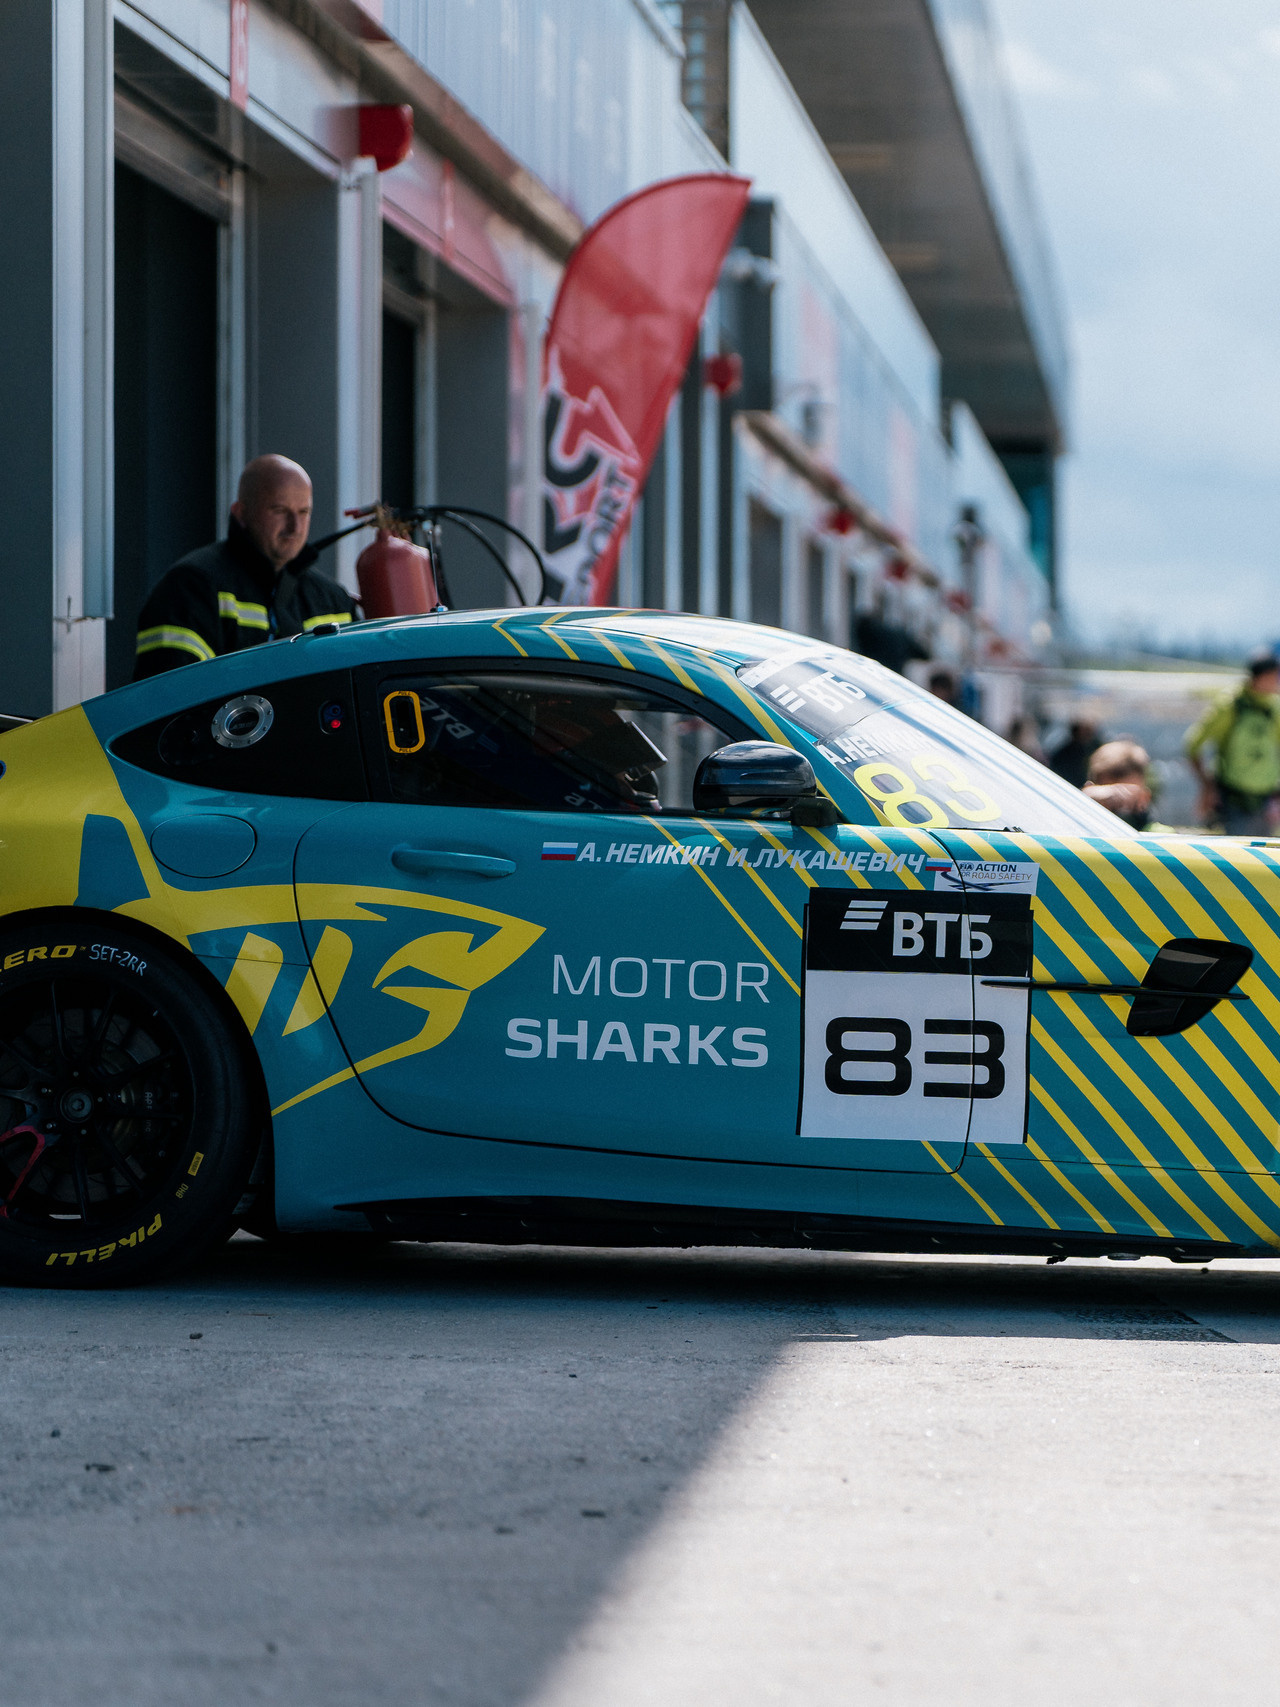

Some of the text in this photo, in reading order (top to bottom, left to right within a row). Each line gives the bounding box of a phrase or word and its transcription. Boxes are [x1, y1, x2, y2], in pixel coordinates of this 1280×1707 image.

[797, 671, 867, 713] ВТБ
[853, 756, 1001, 829] 83
[971, 872, 996, 880] ROAD
[998, 872, 1033, 881] SAFETY
[976, 864, 1017, 872] ACTION
[0, 944, 77, 973] ERO
[88, 943, 147, 977] SET-2RR
[891, 911, 994, 960] ВТБ
[552, 954, 771, 1003] MOTOR
[504, 1017, 769, 1068] SHARKS
[824, 1015, 1006, 1099] 83
[46, 1213, 163, 1266] PIRELLI
